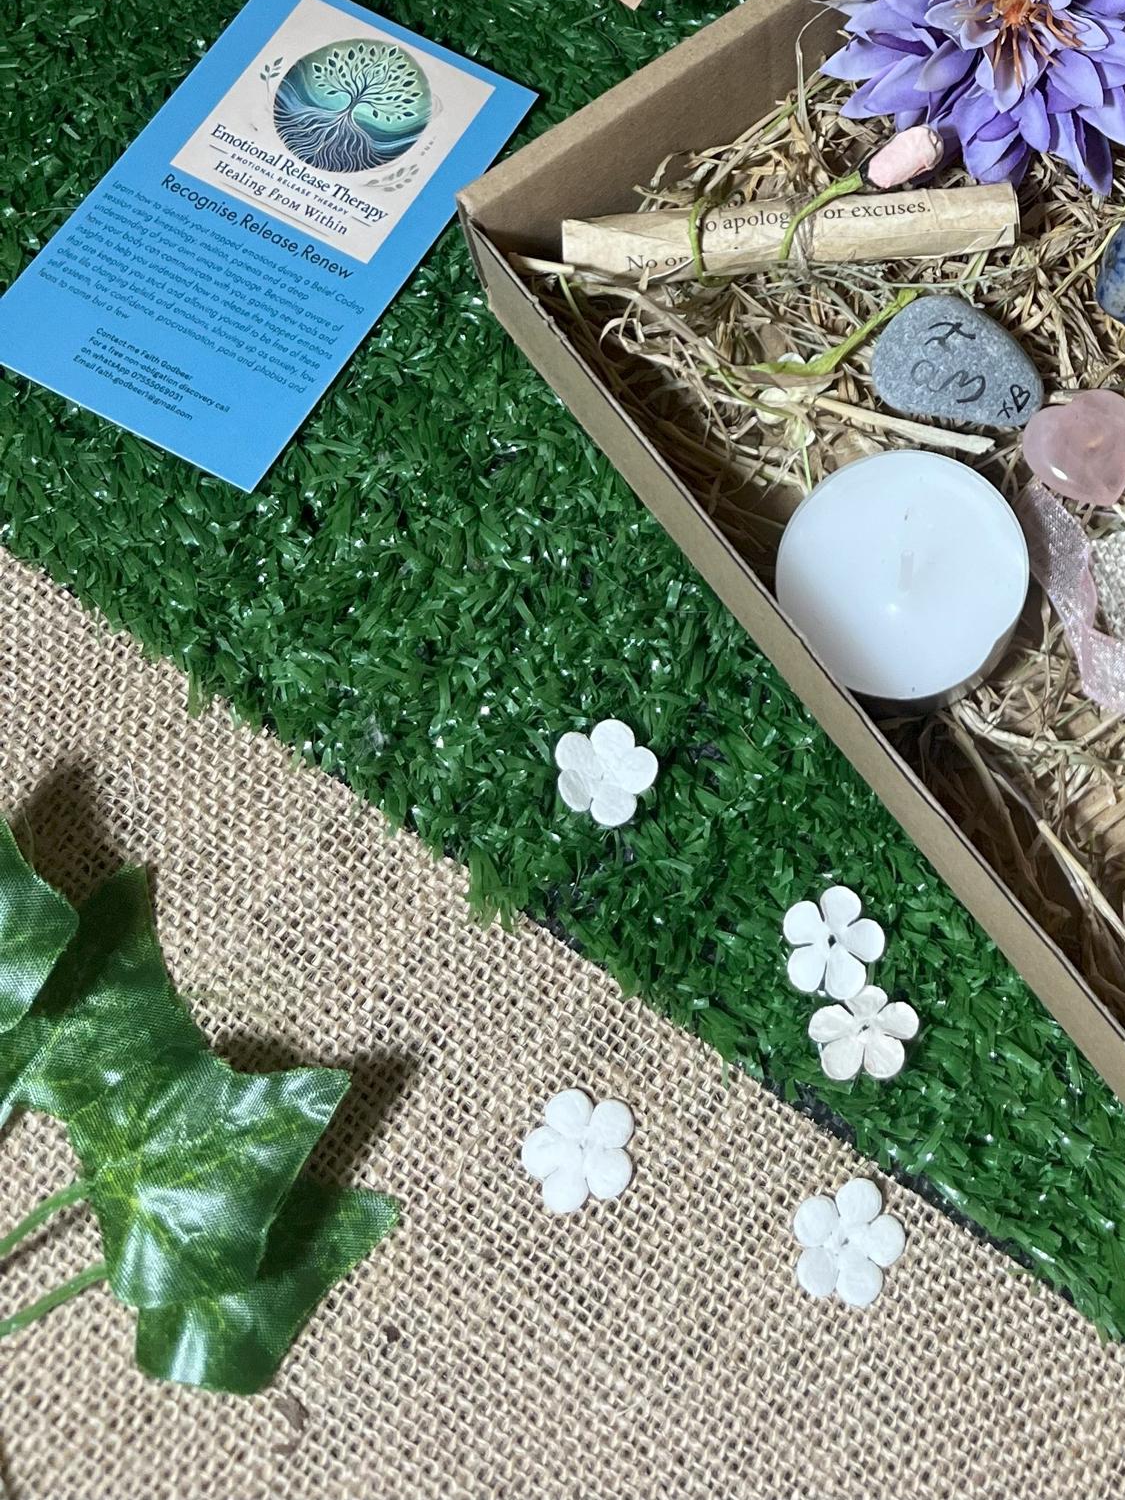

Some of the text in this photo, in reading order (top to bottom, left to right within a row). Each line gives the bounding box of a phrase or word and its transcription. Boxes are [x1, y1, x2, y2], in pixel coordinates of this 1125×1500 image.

[211, 124, 387, 222] Emotional Release Therapy
[231, 153, 347, 214] EMOTIONAL RELEASE THERAPY
[214, 161, 265, 195] Healing
[305, 205, 347, 234] Within
[722, 201, 931, 234] apolog or excuses.
[112, 180, 134, 195] Learn
[335, 293, 364, 314] Coding
[627, 254, 658, 271] No
[122, 231, 143, 248] body
[318, 333, 338, 345] and
[262, 274, 281, 285] and
[155, 298, 175, 309] and
[264, 288, 304, 314] Becoming
[304, 311, 331, 327] aware
[96, 327, 126, 347] Contact
[237, 356, 256, 367] and
[287, 382, 307, 393] and
